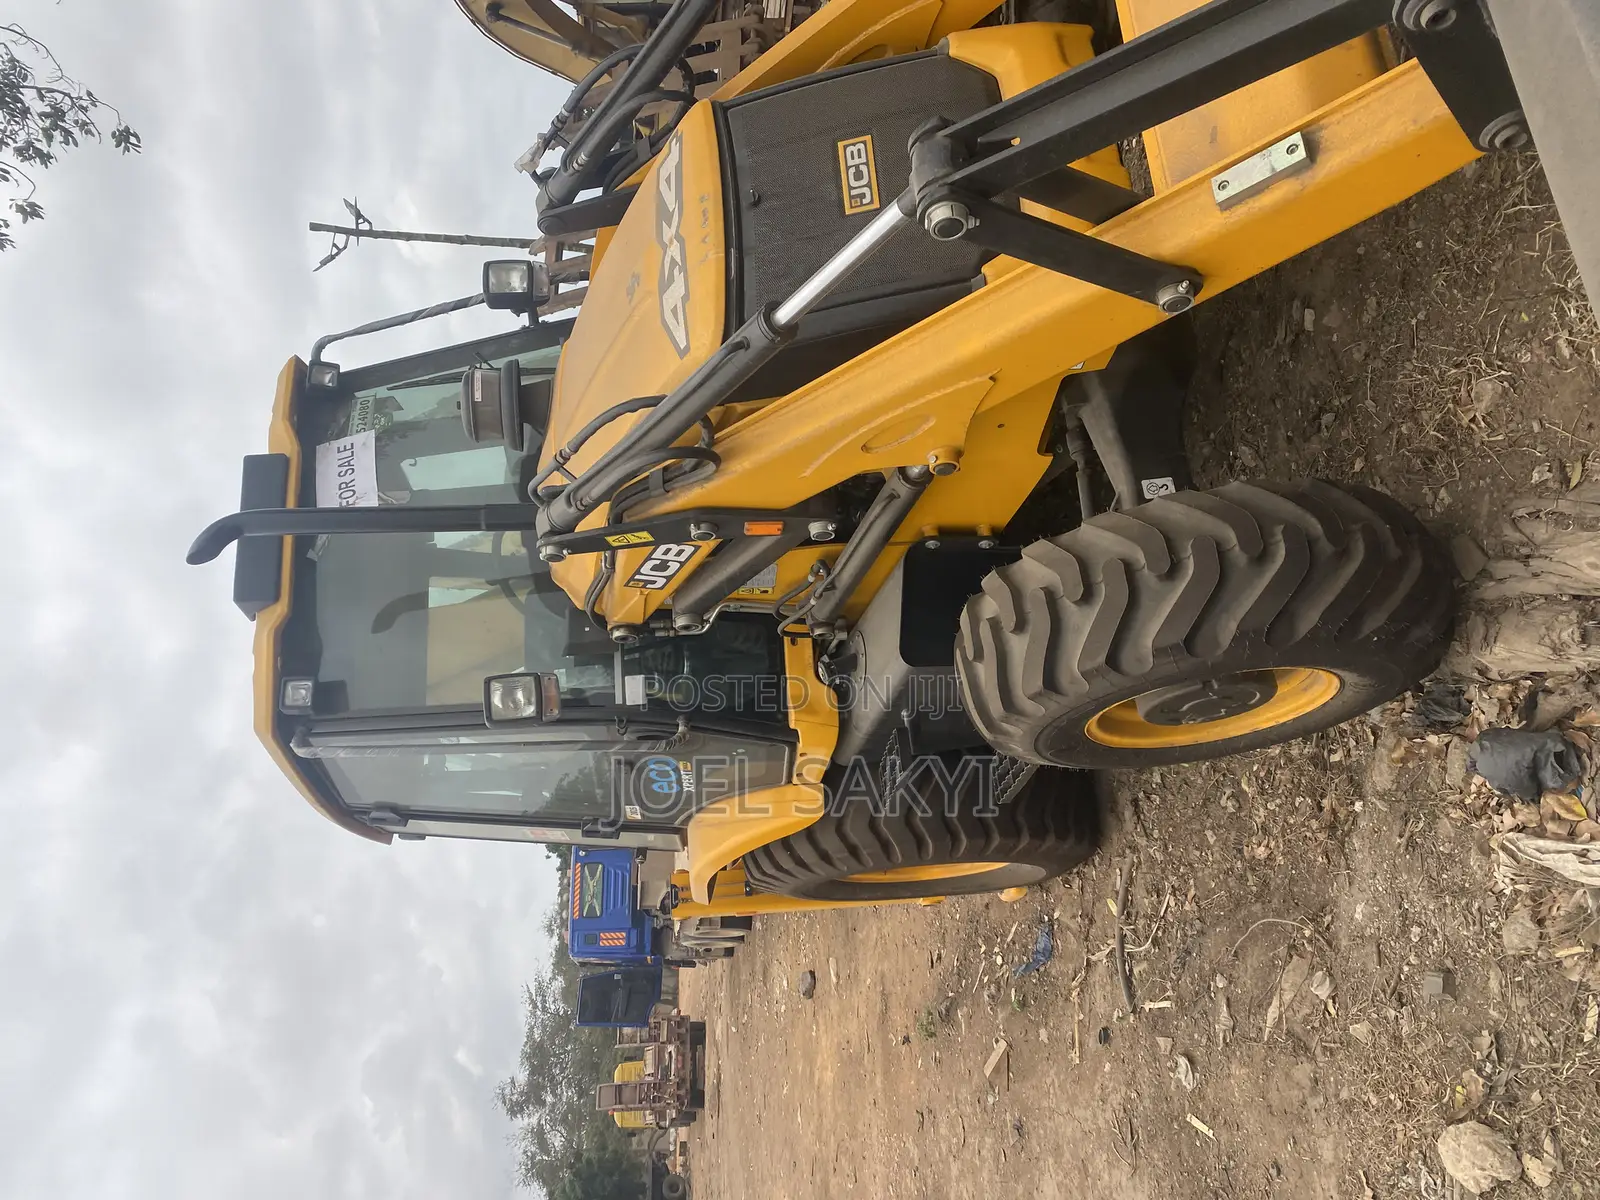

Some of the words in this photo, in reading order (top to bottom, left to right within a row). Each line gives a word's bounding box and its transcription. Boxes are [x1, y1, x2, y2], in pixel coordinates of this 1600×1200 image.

[845, 143, 872, 205] JCB
[337, 443, 354, 477] SALE
[337, 479, 356, 507] FOR
[634, 544, 694, 588] JCB
[648, 758, 680, 792] eco
[681, 770, 695, 792] XPERT
